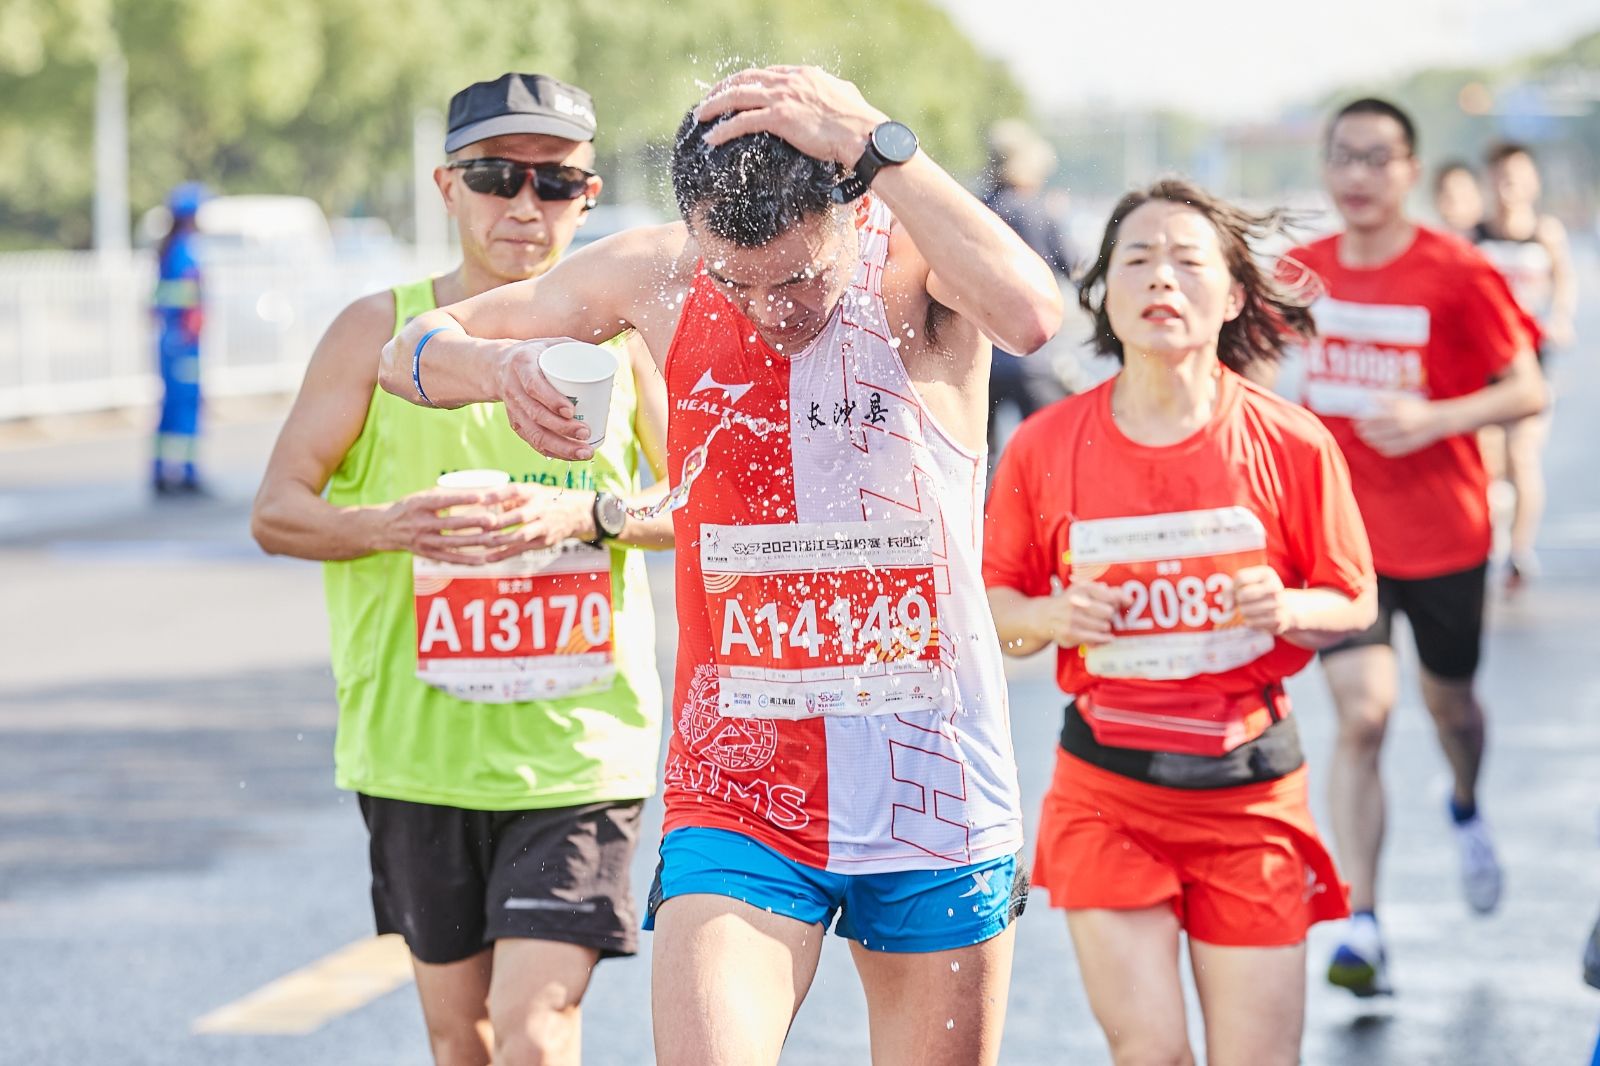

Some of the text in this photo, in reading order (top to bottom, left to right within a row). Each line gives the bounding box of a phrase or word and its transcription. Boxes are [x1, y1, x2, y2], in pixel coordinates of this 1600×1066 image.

[807, 392, 889, 431] 长沙县
[419, 592, 611, 653] A13170
[720, 593, 933, 660] A14149
[1111, 572, 1234, 632] 2083
